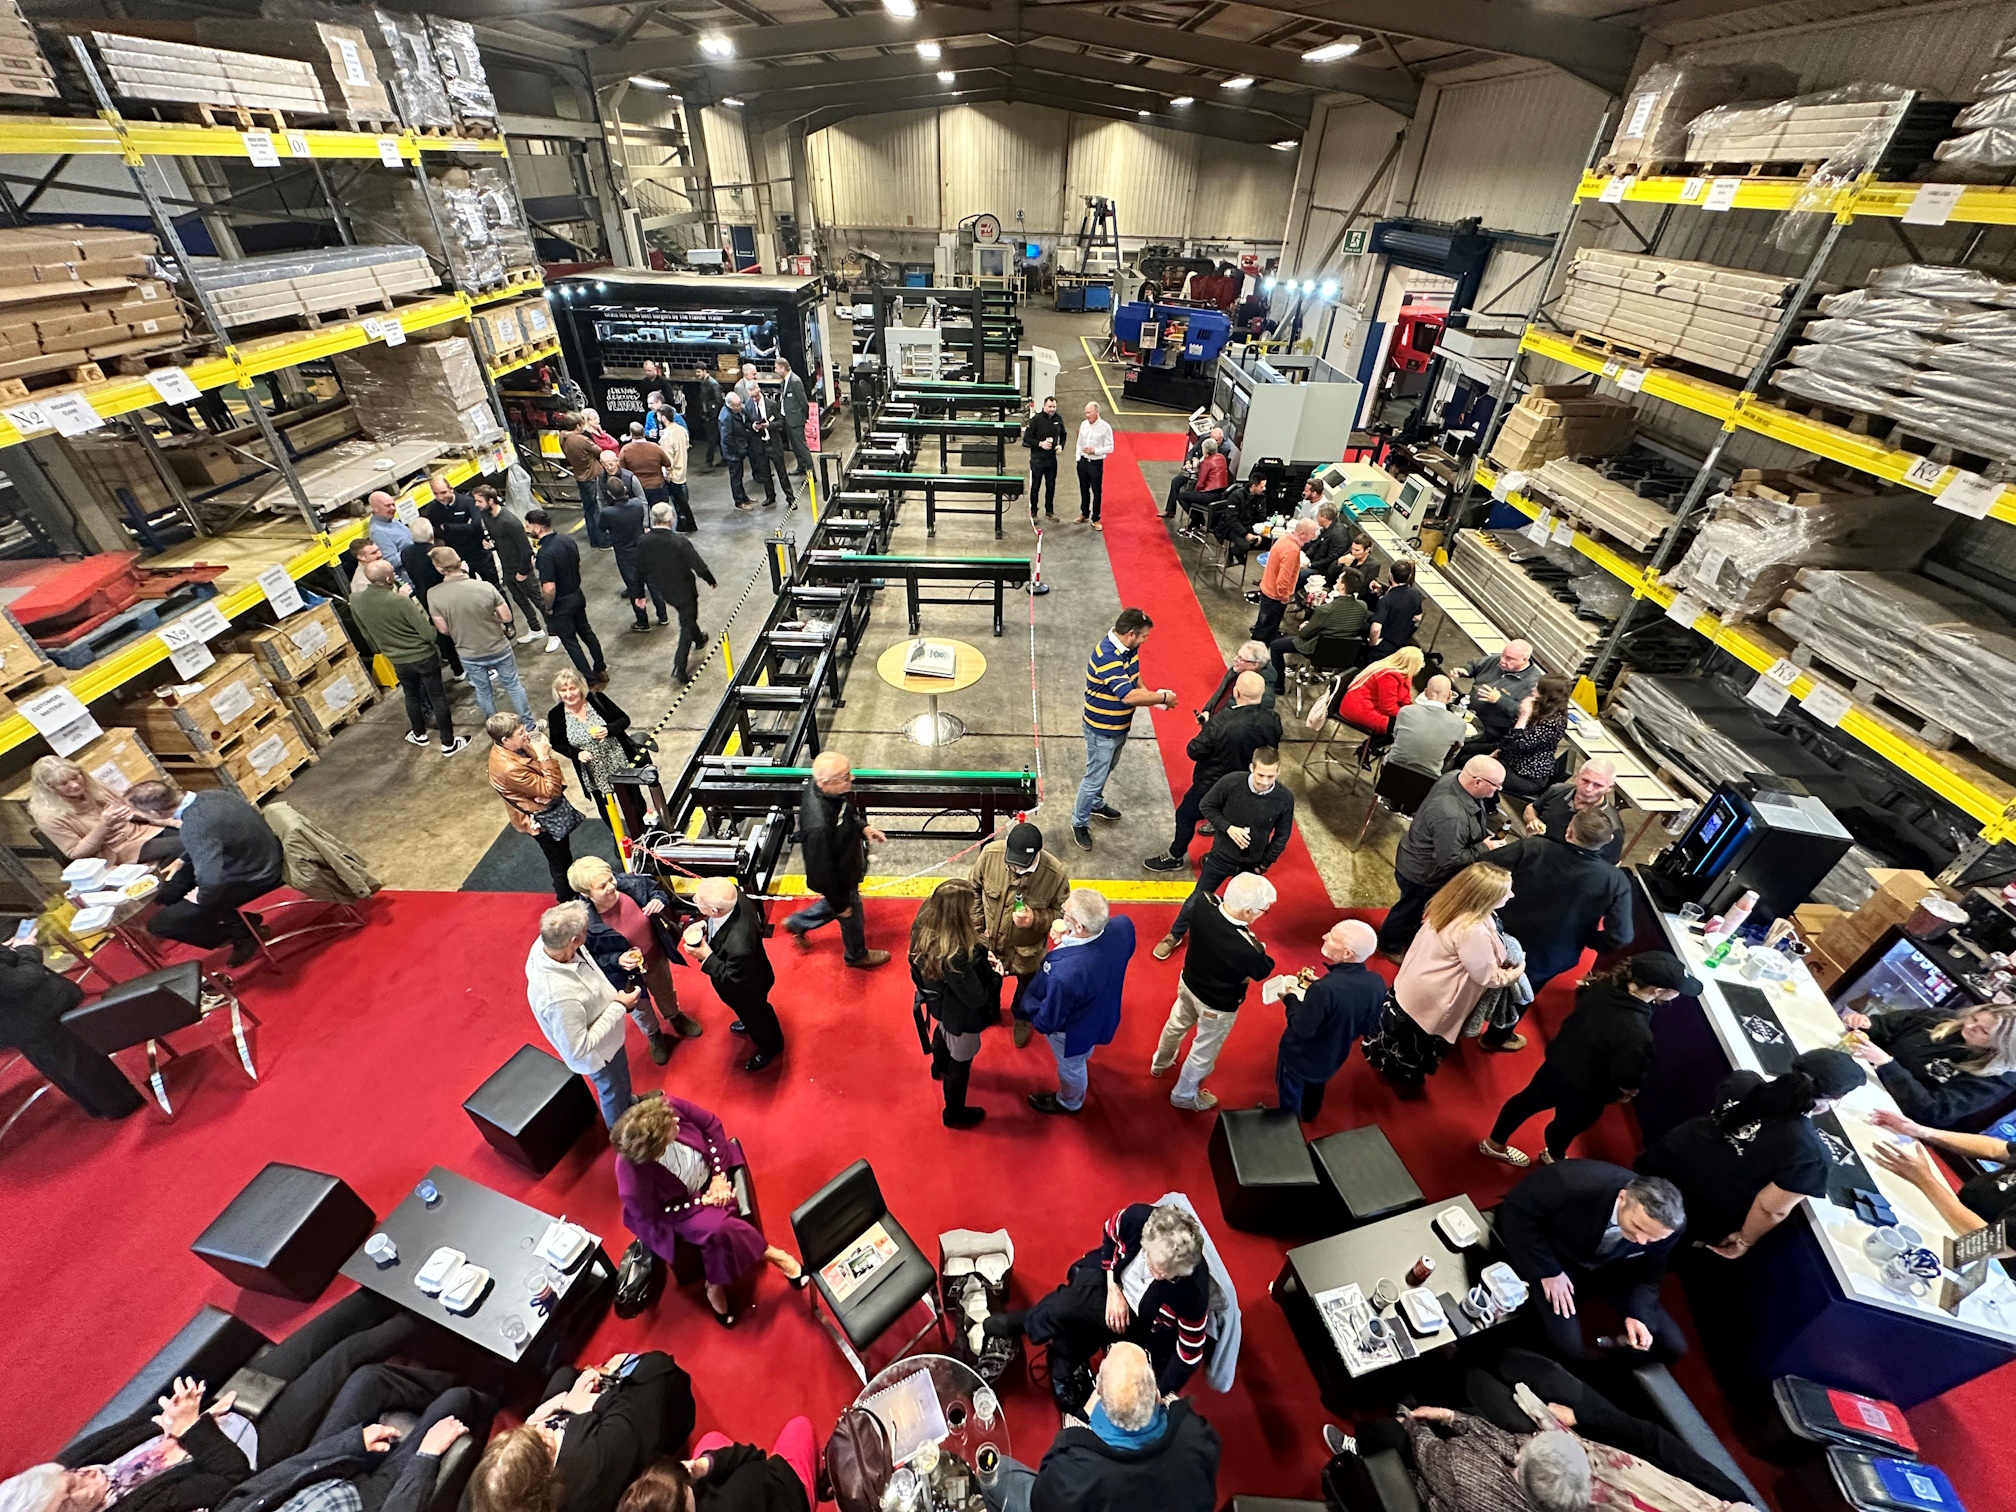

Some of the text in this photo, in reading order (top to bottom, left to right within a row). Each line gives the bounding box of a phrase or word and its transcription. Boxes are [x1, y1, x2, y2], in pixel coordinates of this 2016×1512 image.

[10, 410, 44, 428] N2
[1911, 461, 1940, 482] K2
[1773, 662, 1796, 681] K3
[31, 693, 62, 713] CUSTOMERS
[40, 701, 66, 717] MATERIAL
